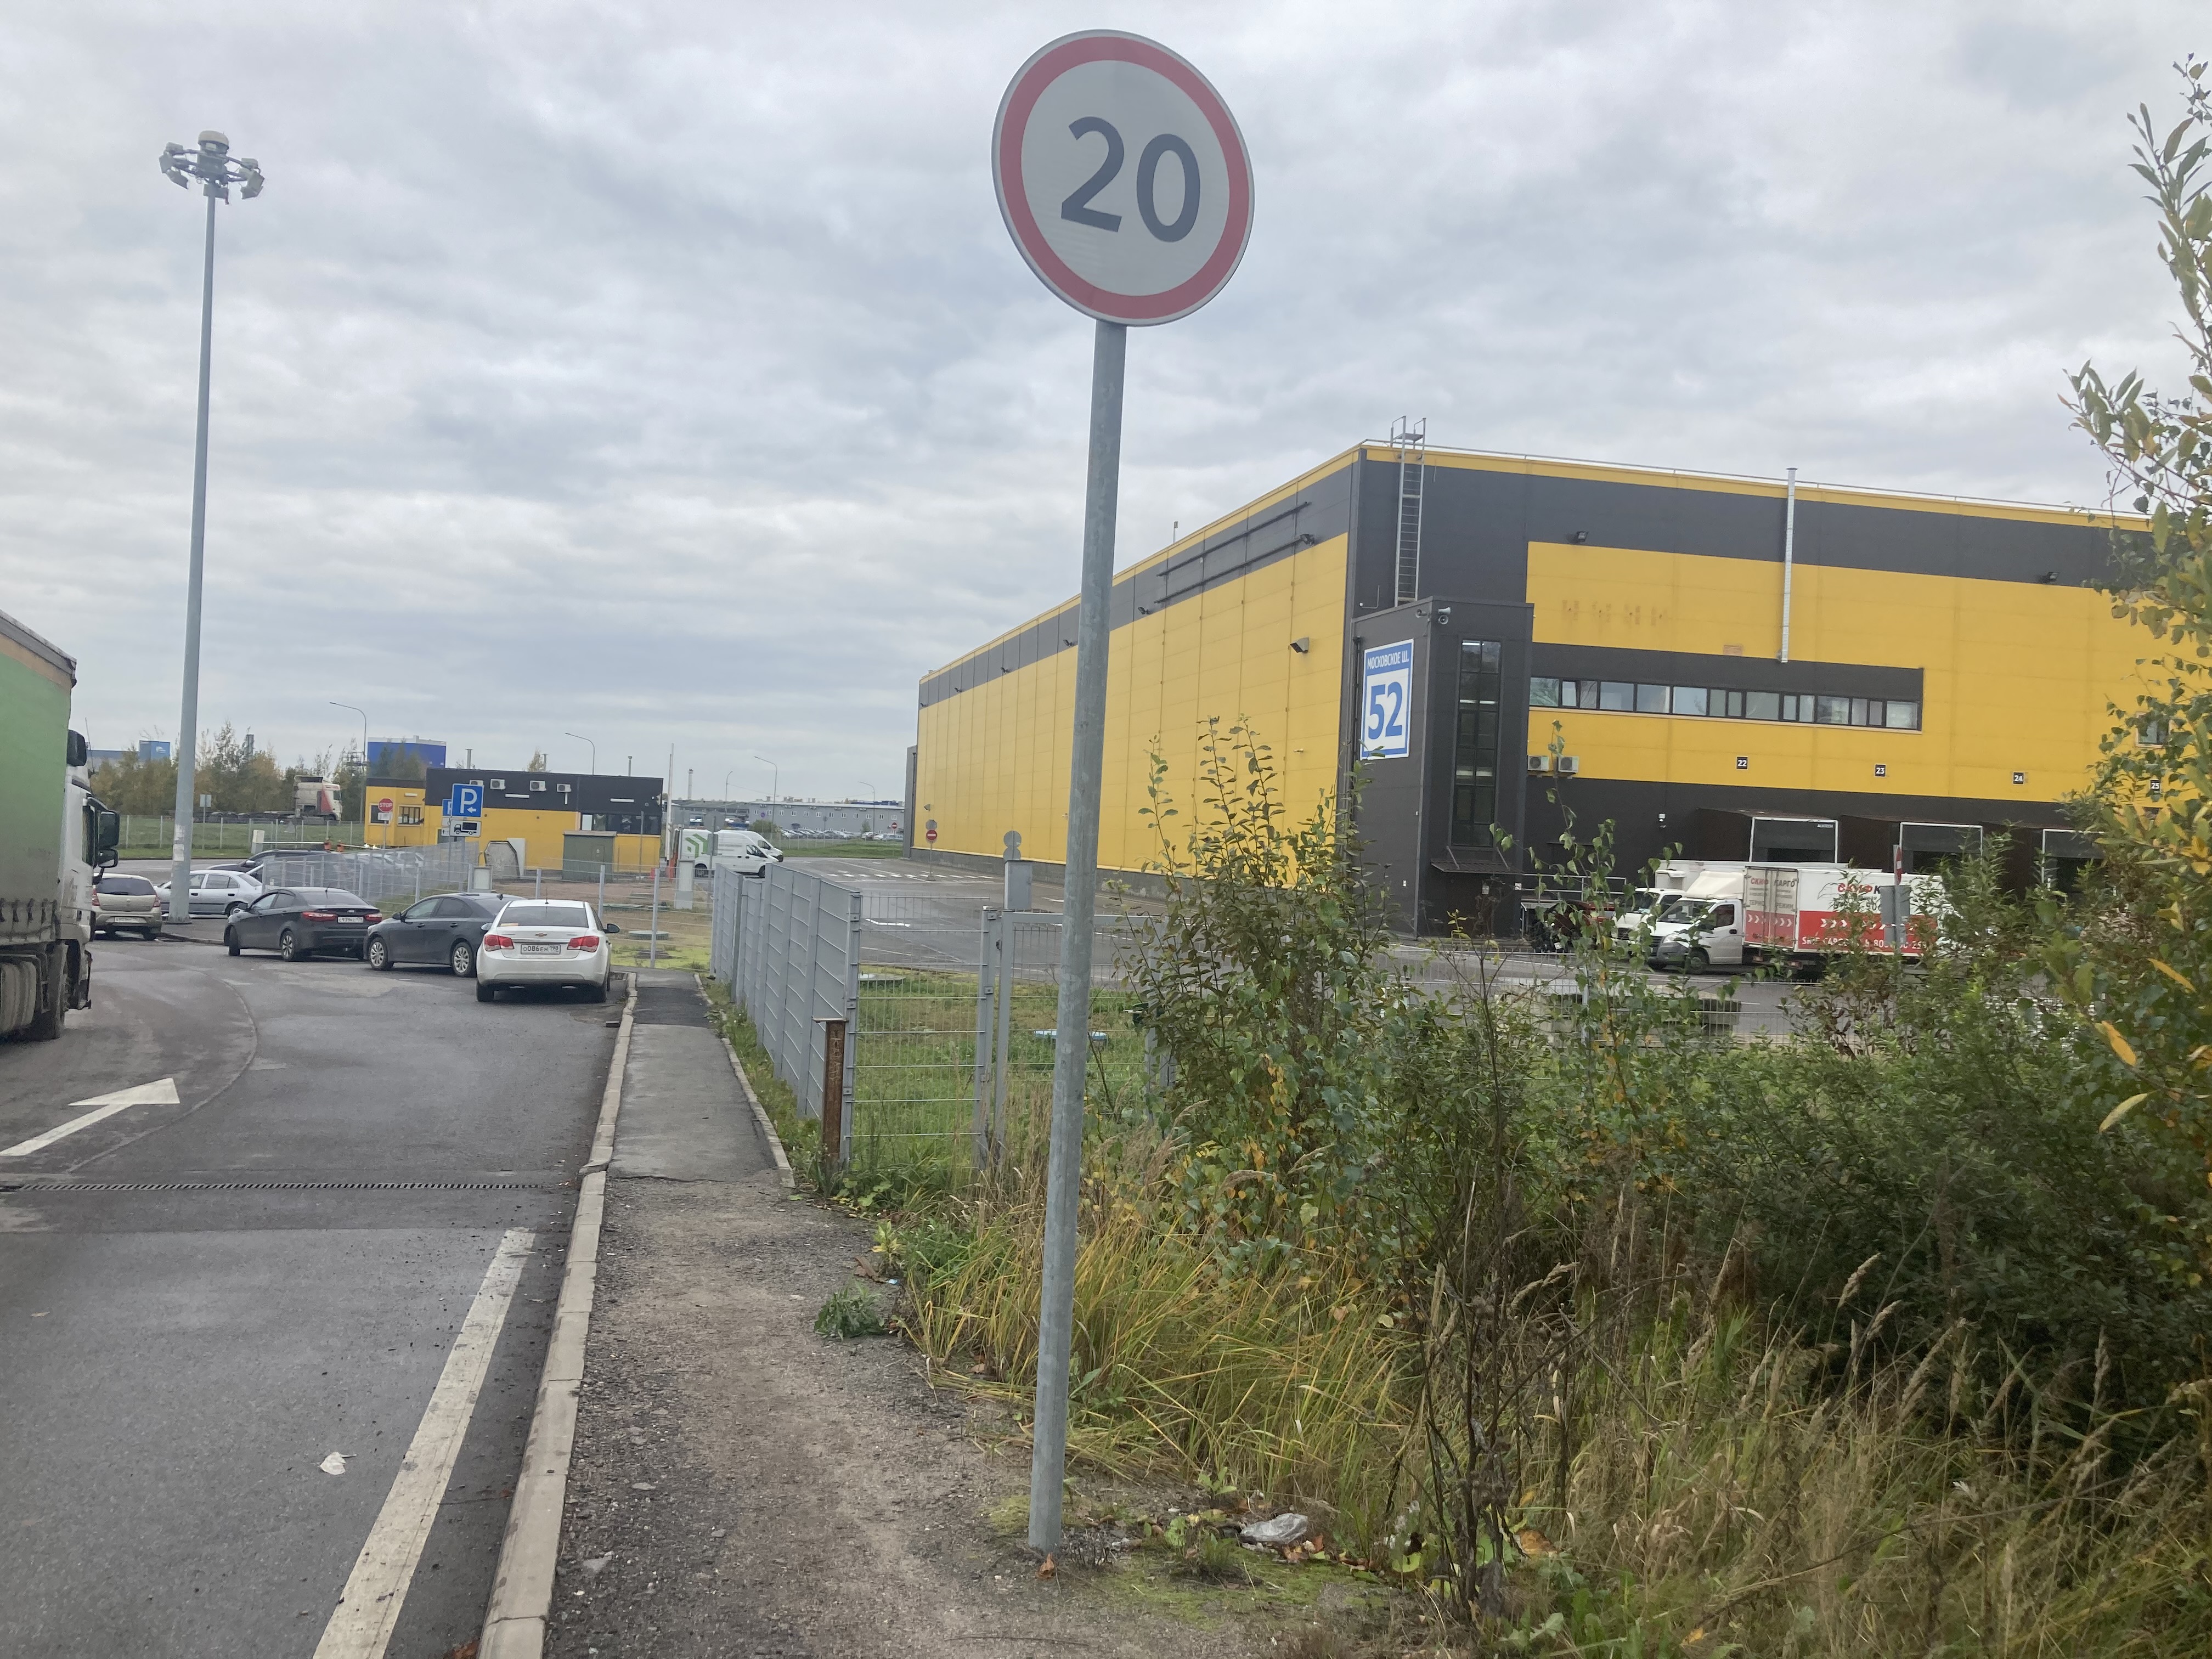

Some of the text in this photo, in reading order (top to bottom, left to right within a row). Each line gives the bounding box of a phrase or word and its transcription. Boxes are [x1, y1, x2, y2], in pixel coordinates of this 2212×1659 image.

[1061, 116, 1200, 242] 20
[1367, 652, 1401, 670] МОСКОВСКОЕ
[1368, 681, 1402, 740] 52
[460, 788, 477, 814] P
